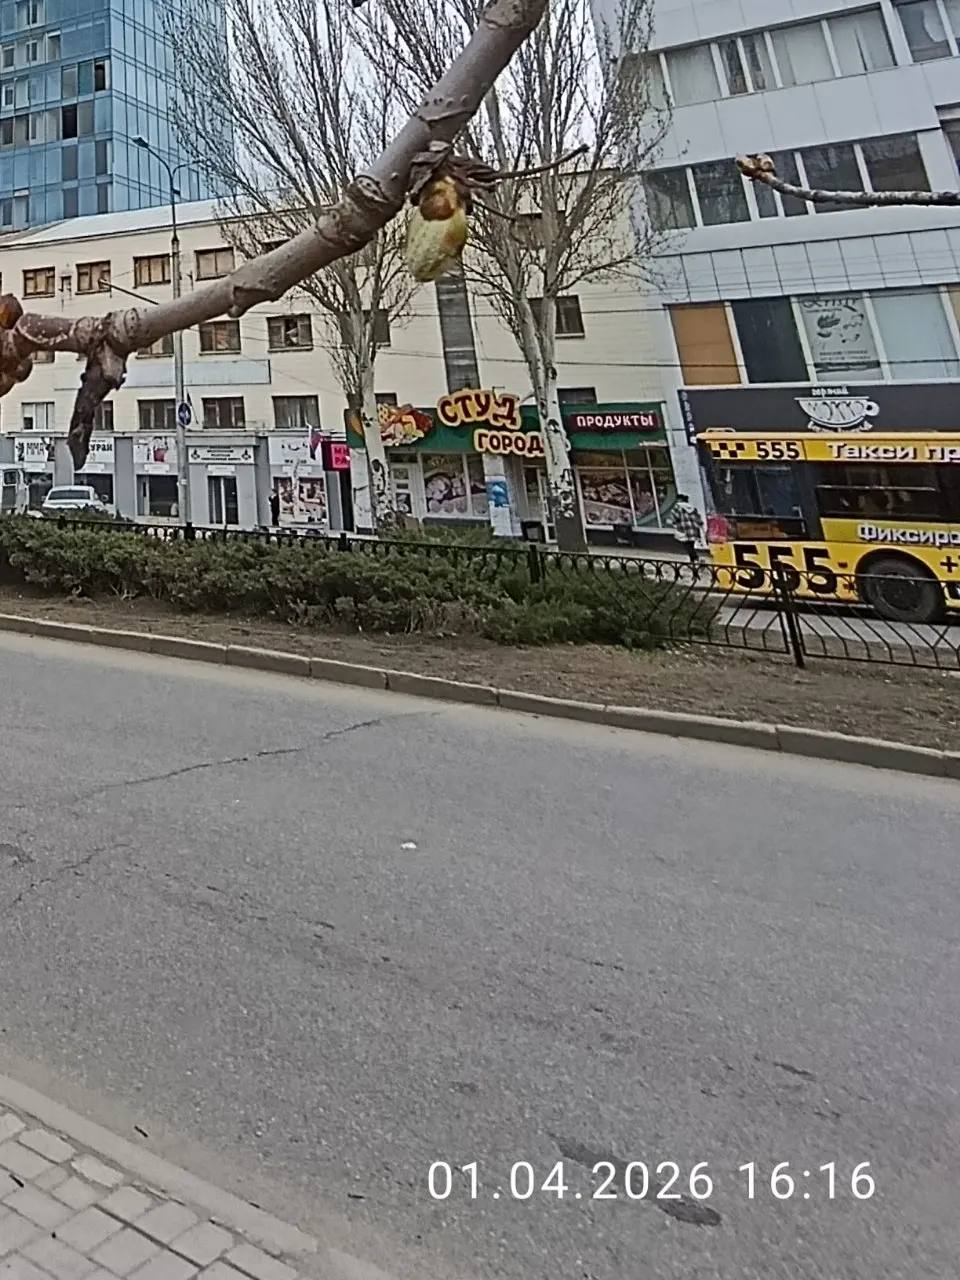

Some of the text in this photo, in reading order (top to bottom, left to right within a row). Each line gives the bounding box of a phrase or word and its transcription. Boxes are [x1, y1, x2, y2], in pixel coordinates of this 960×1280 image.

[440, 393, 517, 426] СТУД
[576, 414, 654, 428] ПРОДУКТЫ
[478, 432, 569, 454] ГОРОД
[756, 441, 800, 460] 555
[826, 443, 918, 461] Такси
[857, 523, 960, 547] Фиксиро
[733, 544, 838, 595] 555
